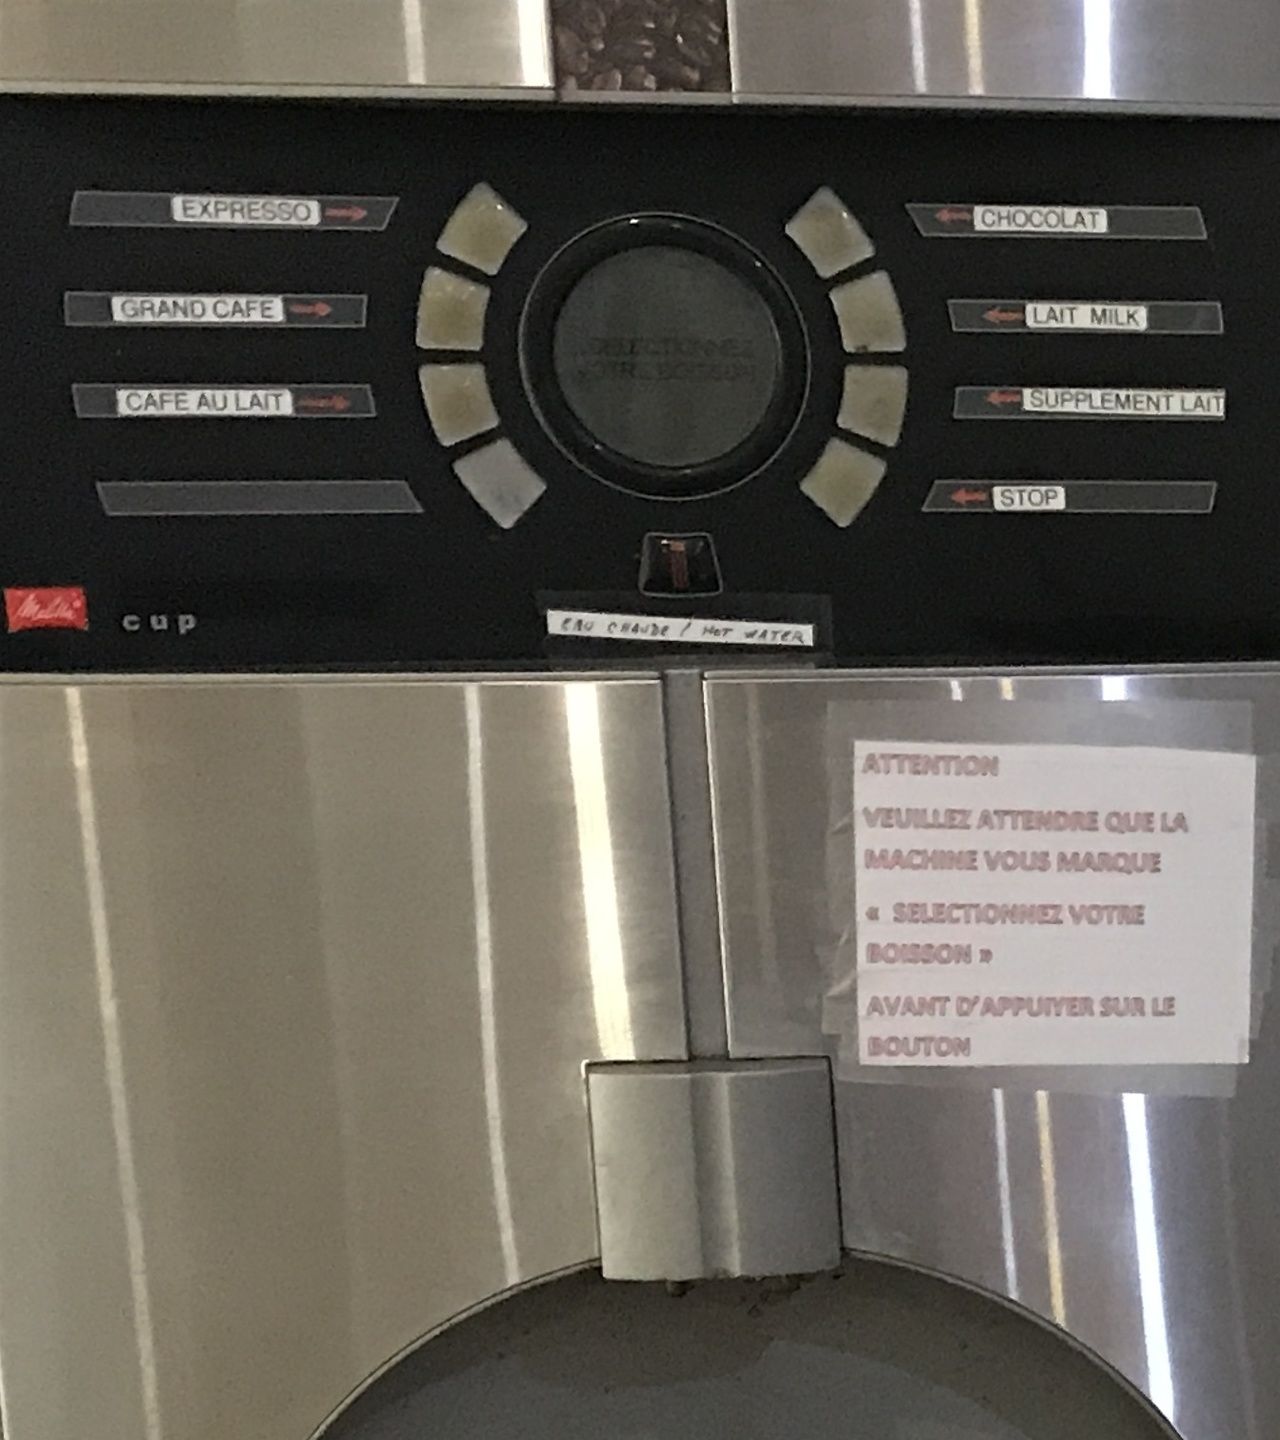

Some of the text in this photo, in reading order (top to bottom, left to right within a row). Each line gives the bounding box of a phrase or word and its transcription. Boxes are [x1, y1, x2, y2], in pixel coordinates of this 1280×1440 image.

[181, 202, 312, 223] EXPRESSO
[980, 208, 1101, 230] CHOCOLAT
[119, 299, 276, 320] GRAND CAFE
[1031, 306, 1141, 326] LAIT MILK
[124, 392, 284, 412] CAFE AU LAIT
[1029, 390, 1224, 413] SUPPLEMENT LAIT
[1000, 488, 1059, 509] STOP
[122, 614, 197, 635] cup
[861, 752, 1000, 777] ATTENTION
[862, 807, 1189, 835] VEUILLEZ ATTENDRE QUE LA
[864, 849, 1162, 876] MACHINE VOUS MARQUE
[892, 903, 1064, 926] SELECTIONNEZ
[1068, 904, 1146, 926] VOTRE
[866, 943, 973, 965] BOISSON
[866, 996, 952, 1018] AVANT
[1099, 996, 1146, 1018] SUR
[1151, 996, 1176, 1018] LE
[866, 1036, 972, 1058] BOUTON
